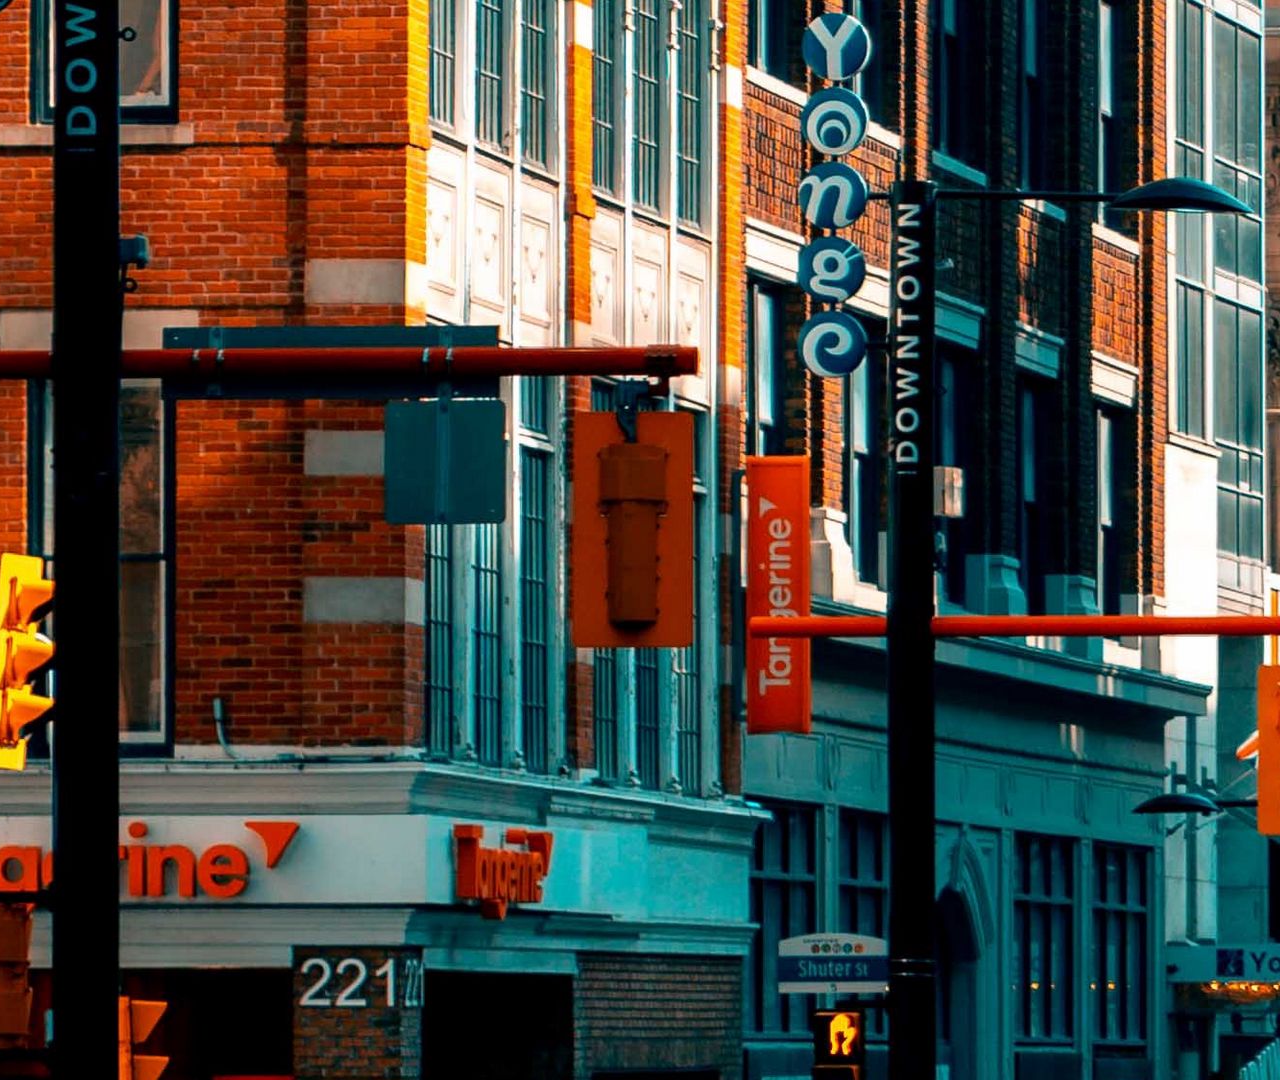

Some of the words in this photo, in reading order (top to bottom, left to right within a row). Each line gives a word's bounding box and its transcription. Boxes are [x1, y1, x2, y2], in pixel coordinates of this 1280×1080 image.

[799, 12, 871, 377] Yonge
[894, 203, 920, 464] DOWNTOWN
[299, 957, 398, 1008] 221
[798, 959, 853, 978] Shuter
